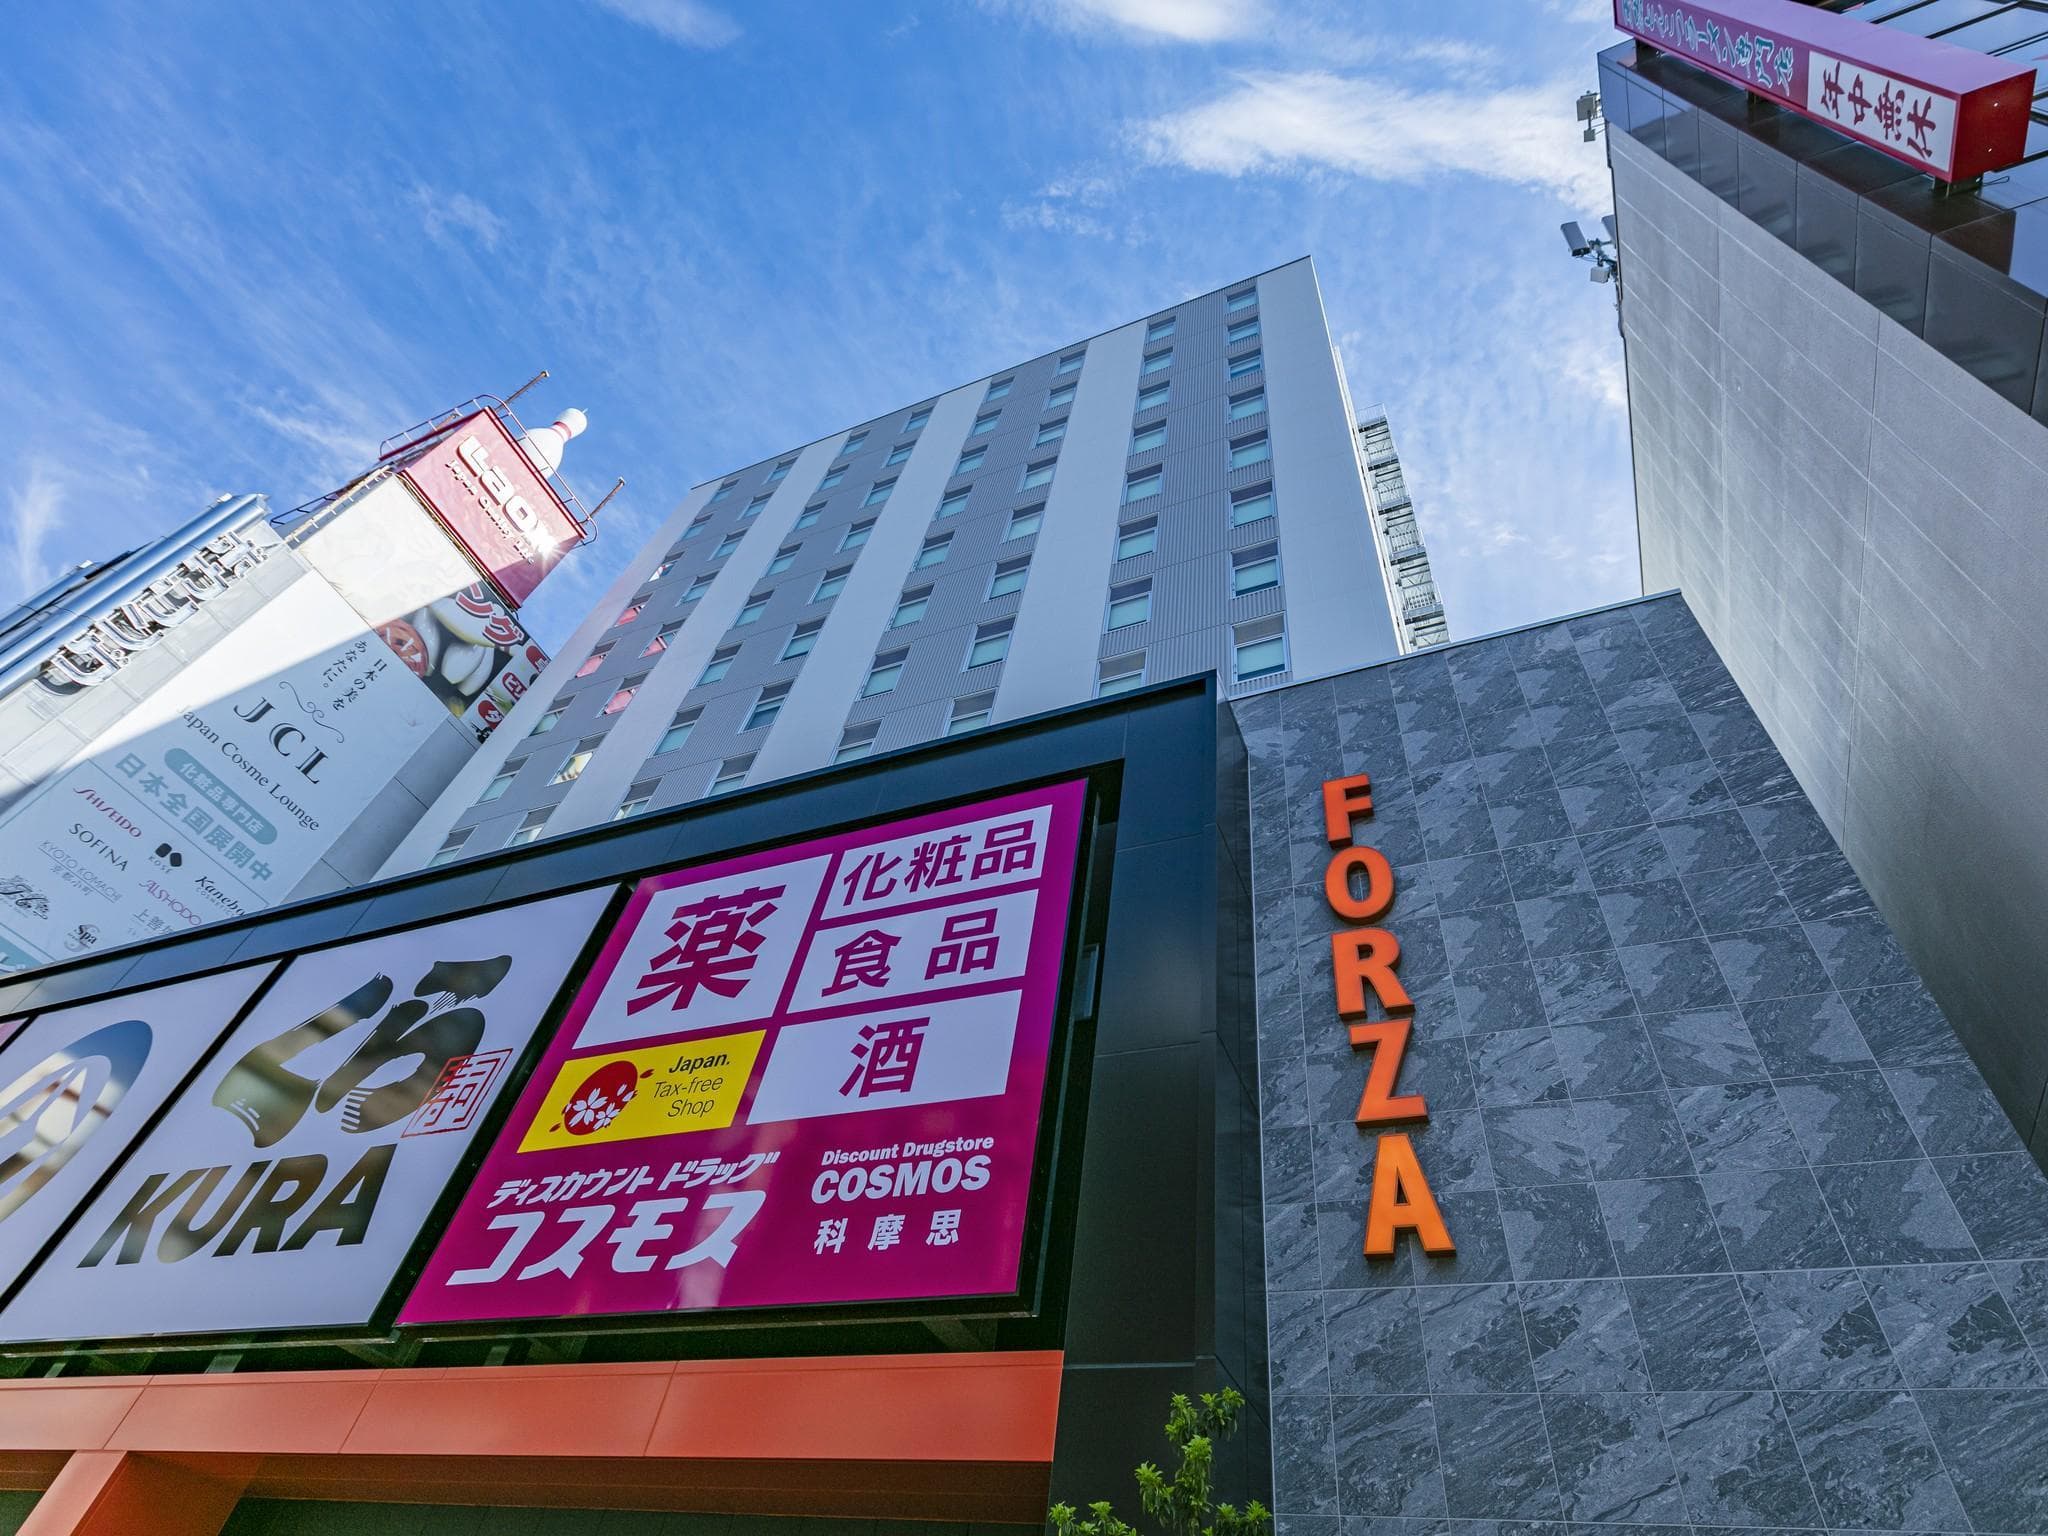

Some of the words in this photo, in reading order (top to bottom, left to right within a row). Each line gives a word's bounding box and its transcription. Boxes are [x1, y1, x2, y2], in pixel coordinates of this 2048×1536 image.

[1820, 61, 1937, 159] 年中無休
[334, 659, 387, 711] 日本の美を
[233, 697, 328, 785] JCL
[73, 787, 142, 838] SHISEIDO
[115, 752, 273, 882] 日本全国展開中
[179, 762, 265, 835] 化粧品専門店
[221, 741, 269, 787] Cosme
[269, 783, 320, 832] Lounge
[40, 840, 78, 868] KYOTO
[69, 823, 129, 872] SOFINA
[843, 818, 1037, 907] 化粧品
[195, 876, 246, 916] Kanebo
[627, 886, 786, 1016] 薬
[821, 908, 998, 997] 食品
[211, 955, 512, 1148] くら
[1322, 773, 1457, 1260] FORZA
[653, 1076, 723, 1100] Tax-free
[839, 1017, 930, 1099] 酒
[667, 1097, 714, 1119] Shop
[486, 1165, 654, 1209] ディスカウント
[660, 1151, 781, 1193] ドラッグ
[811, 1154, 991, 1205] COSMOS
[821, 1143, 900, 1166] Discount
[902, 1135, 995, 1163] Drugstore
[77, 1144, 398, 1268] KURA
[445, 1190, 767, 1286] コスモス
[813, 1208, 962, 1255] 科摩思
